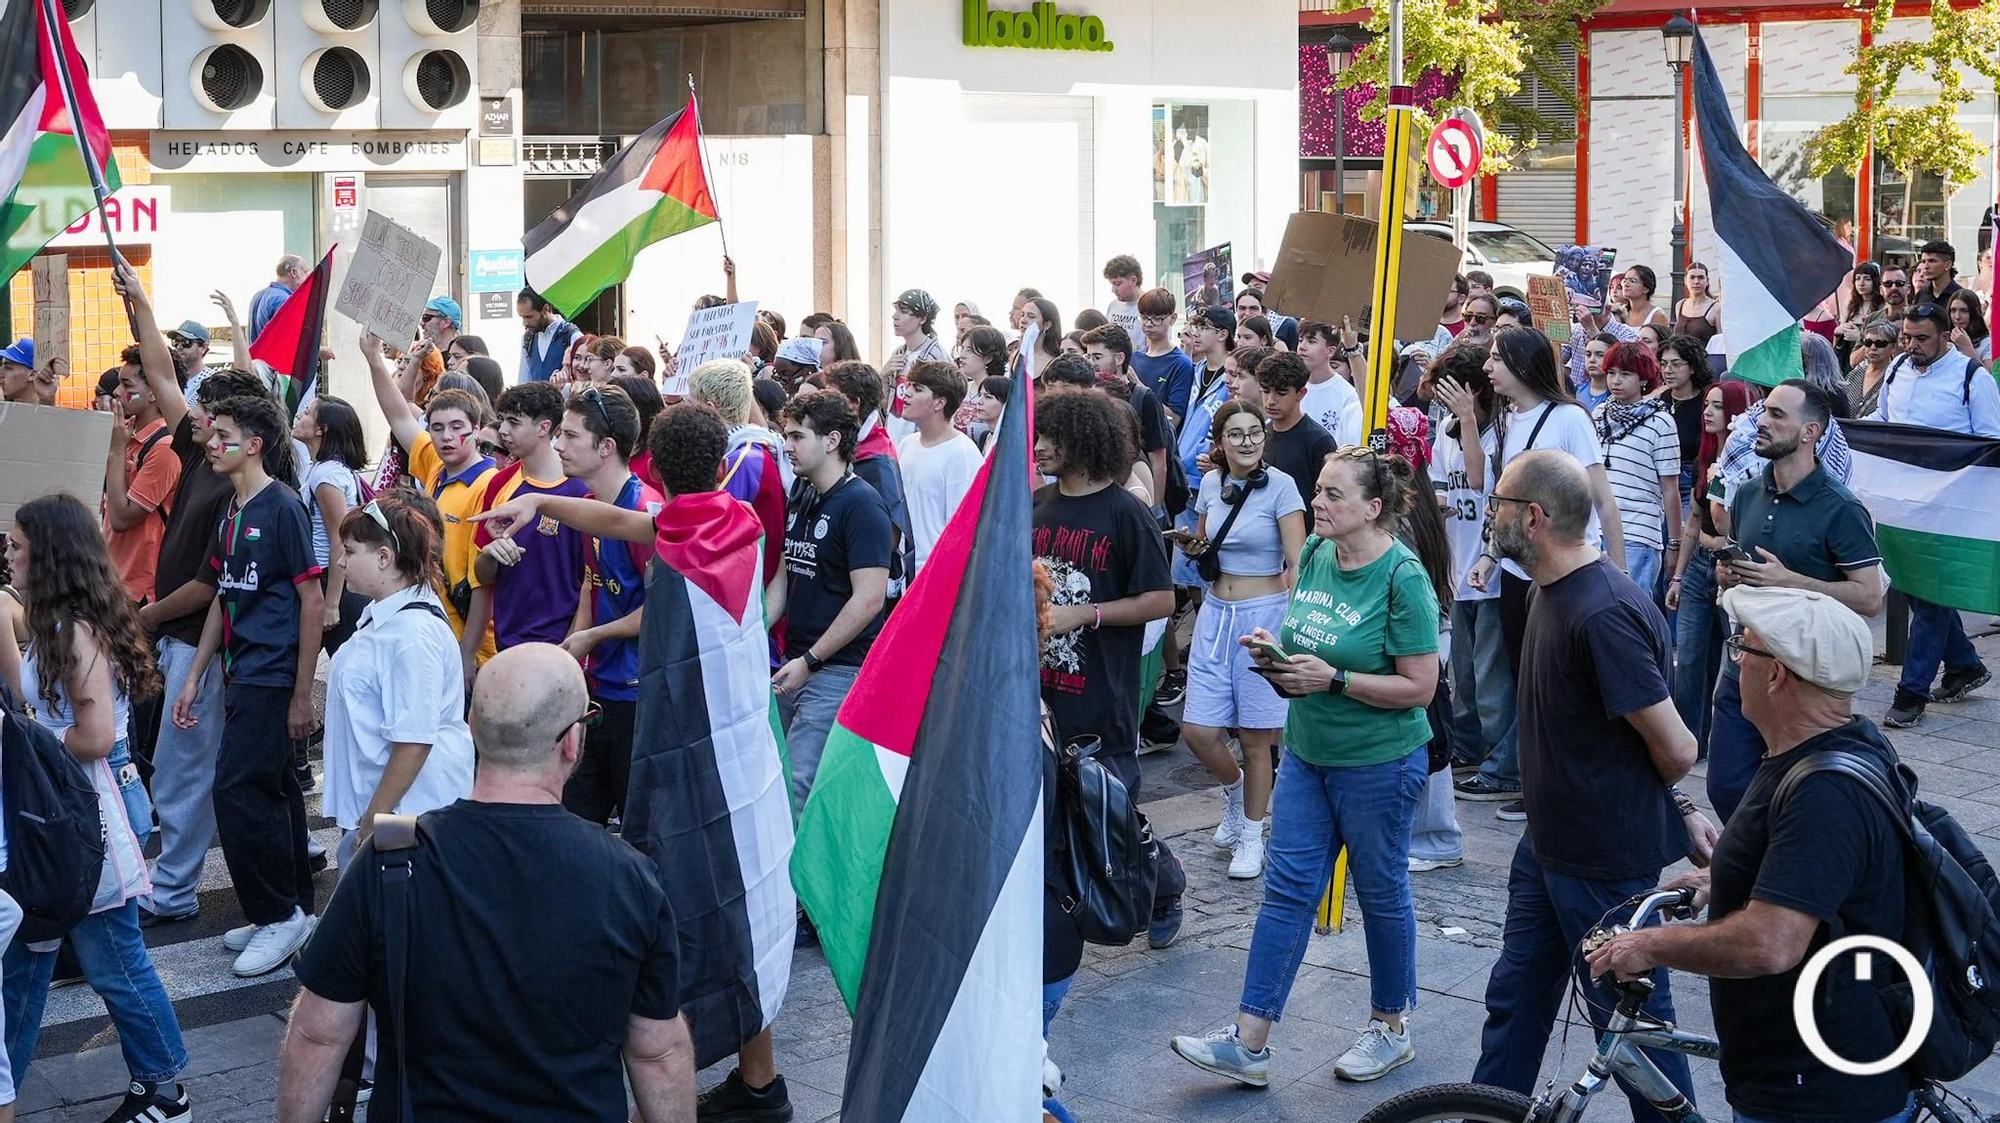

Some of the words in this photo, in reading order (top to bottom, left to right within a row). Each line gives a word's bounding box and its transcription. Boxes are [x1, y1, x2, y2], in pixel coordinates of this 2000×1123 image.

[168, 141, 259, 156] HELADOS
[282, 141, 329, 156] CAFE
[351, 140, 450, 156] BOMBONES
[1111, 313, 1138, 324] TOMMY
[1294, 588, 1335, 610] MARINA
[1334, 602, 1362, 626] CLUB
[1306, 609, 1333, 626] 2024
[1284, 615, 1300, 630] LOS
[1299, 623, 1338, 646] ANGELES
[1293, 632, 1319, 653] VENICE
